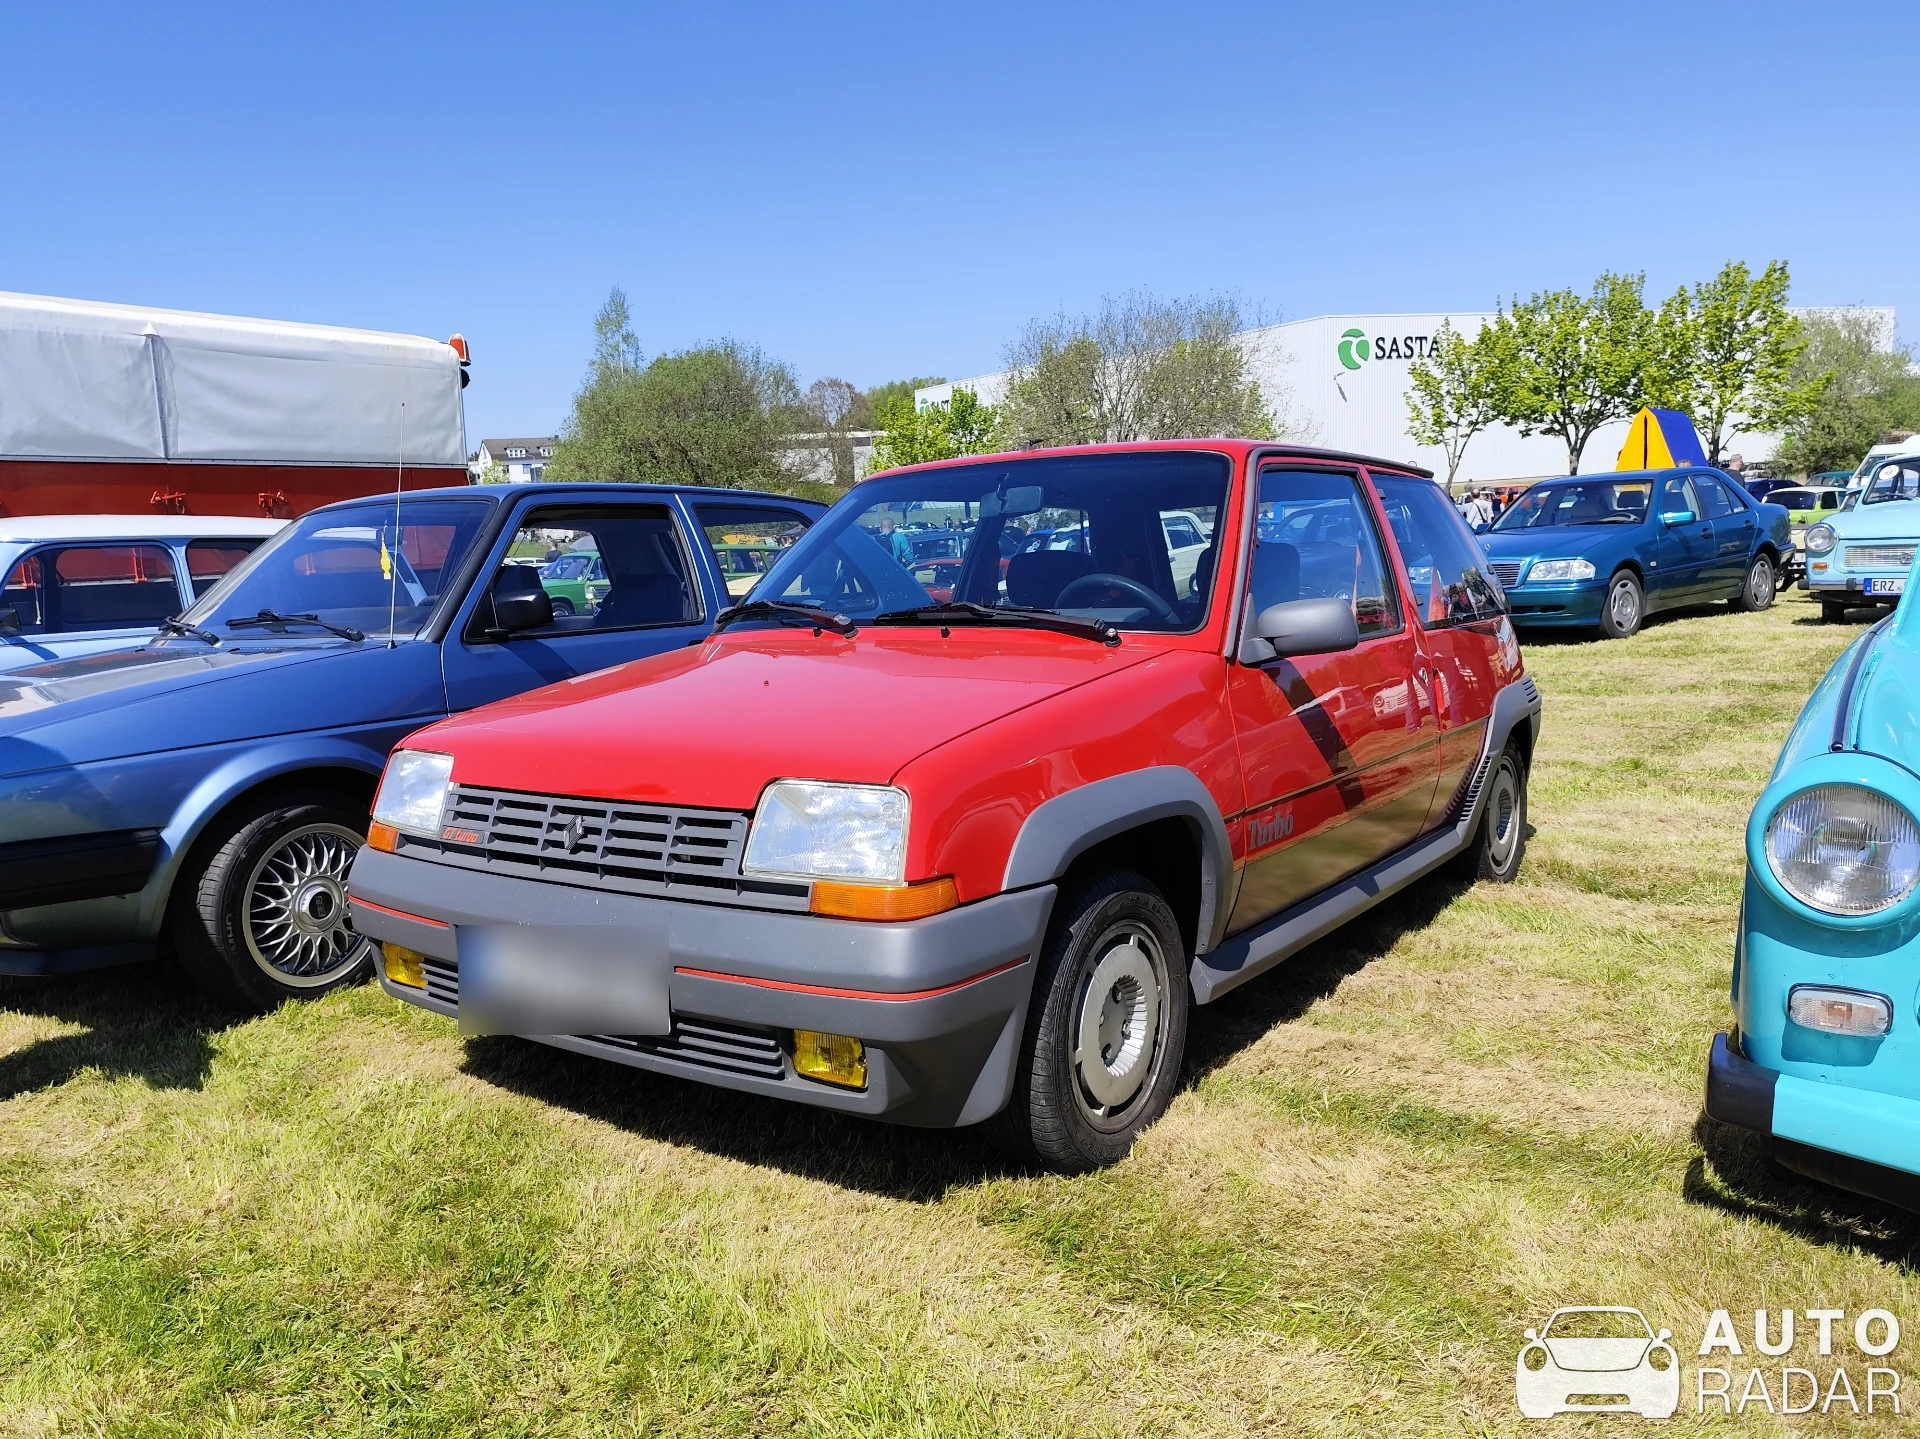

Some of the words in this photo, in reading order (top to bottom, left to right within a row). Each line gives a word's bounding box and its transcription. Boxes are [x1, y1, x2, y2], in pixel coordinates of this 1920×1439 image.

[1872, 581, 1895, 591] ERZ
[443, 826, 457, 840] GT
[1248, 811, 1294, 850] Turbo
